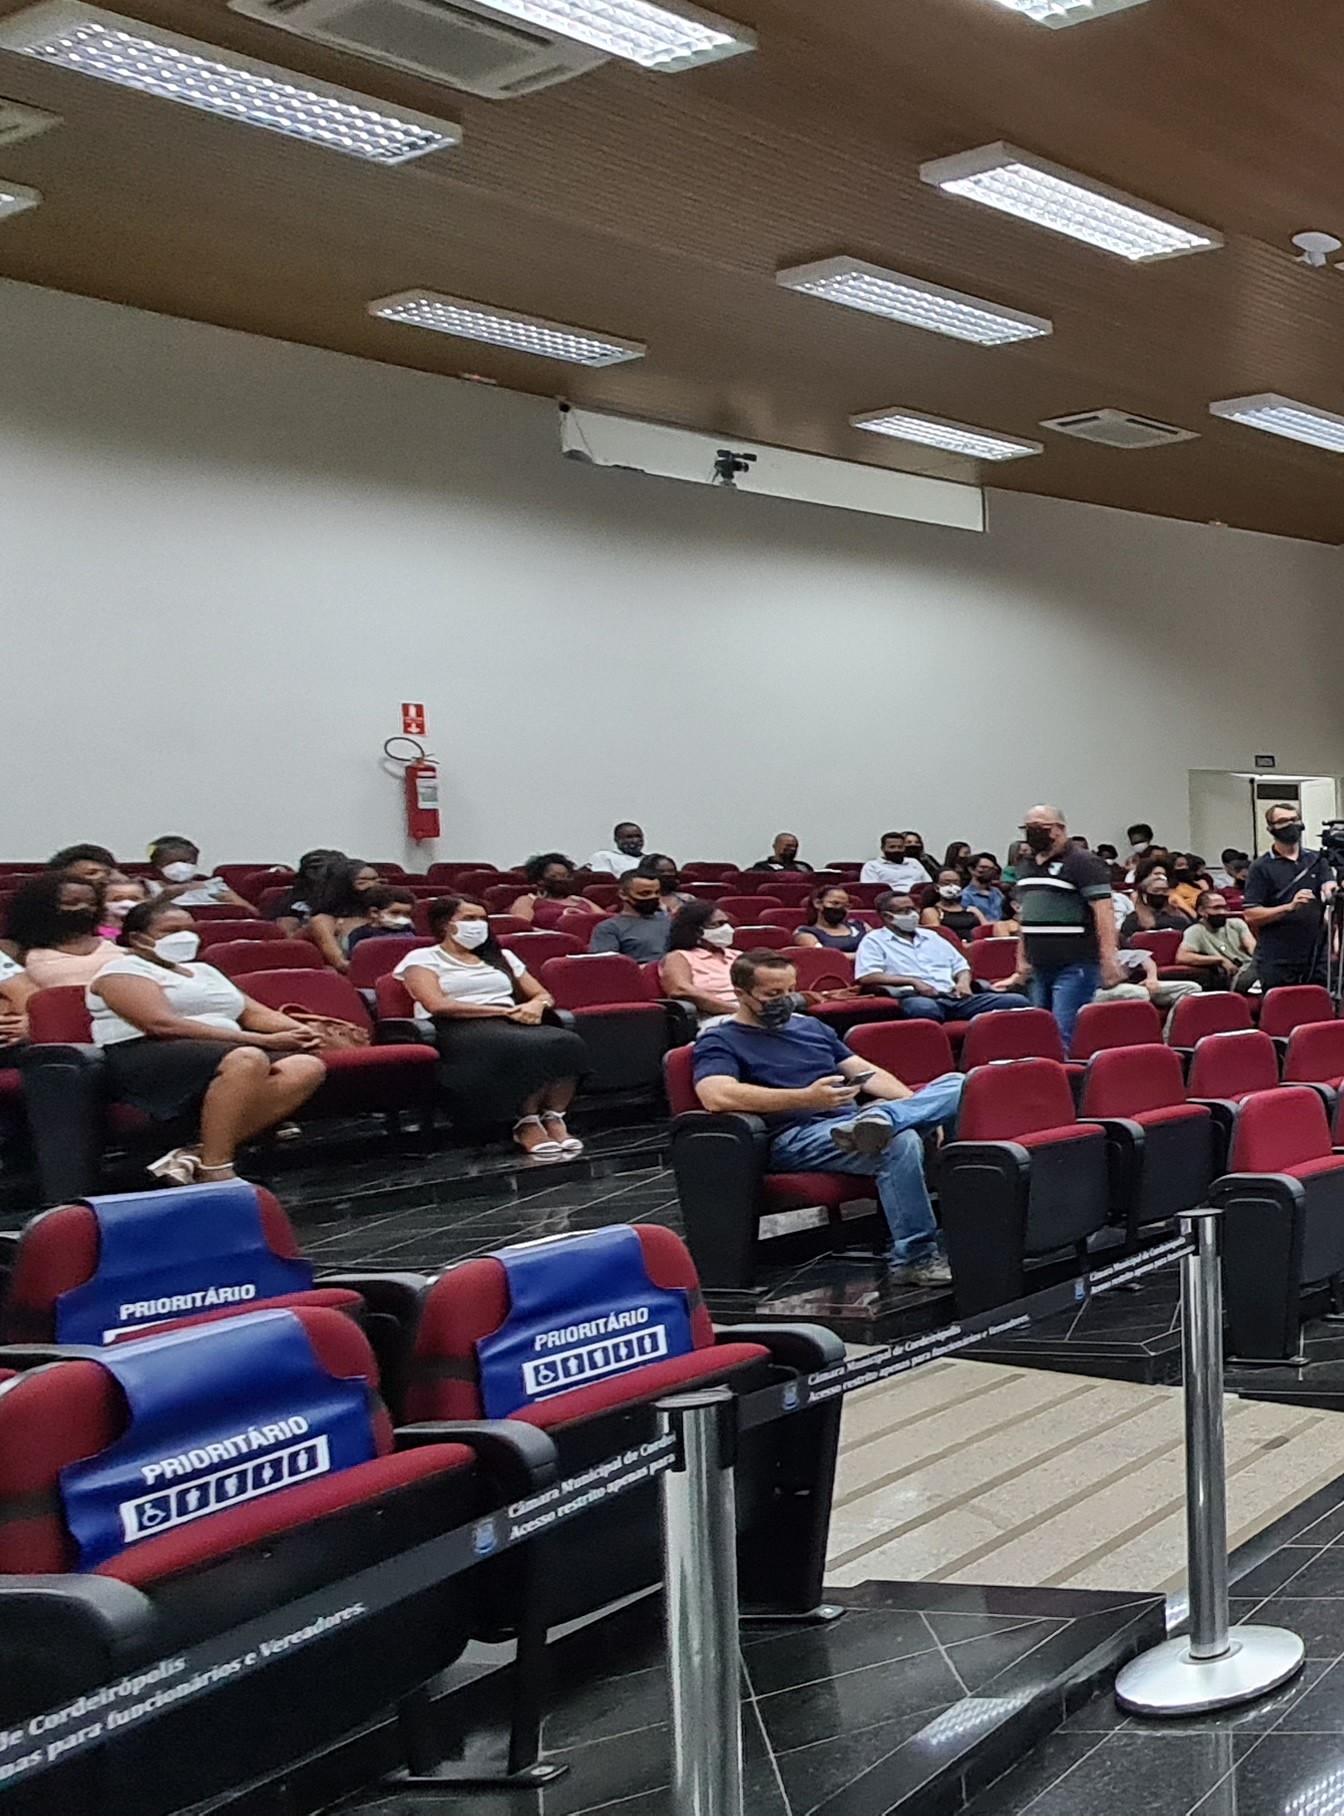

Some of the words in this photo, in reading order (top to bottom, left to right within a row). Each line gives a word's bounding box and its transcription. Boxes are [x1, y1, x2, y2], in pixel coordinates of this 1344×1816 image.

[119, 1283, 256, 1321] PRIORITÁRIO
[533, 1307, 649, 1352] PRIORITÁRIO
[140, 1415, 309, 1486] PRIORITÁRIO
[507, 1488, 561, 1519] Câmara
[561, 1455, 623, 1495] Municipal
[623, 1450, 639, 1465] de
[509, 1510, 556, 1540] Acesso
[557, 1486, 606, 1518] restrito
[606, 1465, 649, 1493] apenas
[649, 1453, 676, 1476] para
[28, 1656, 187, 1736] Cordeirópolis
[47, 1722, 103, 1762] para
[106, 1658, 242, 1730] funcionários
[244, 1650, 257, 1666] e
